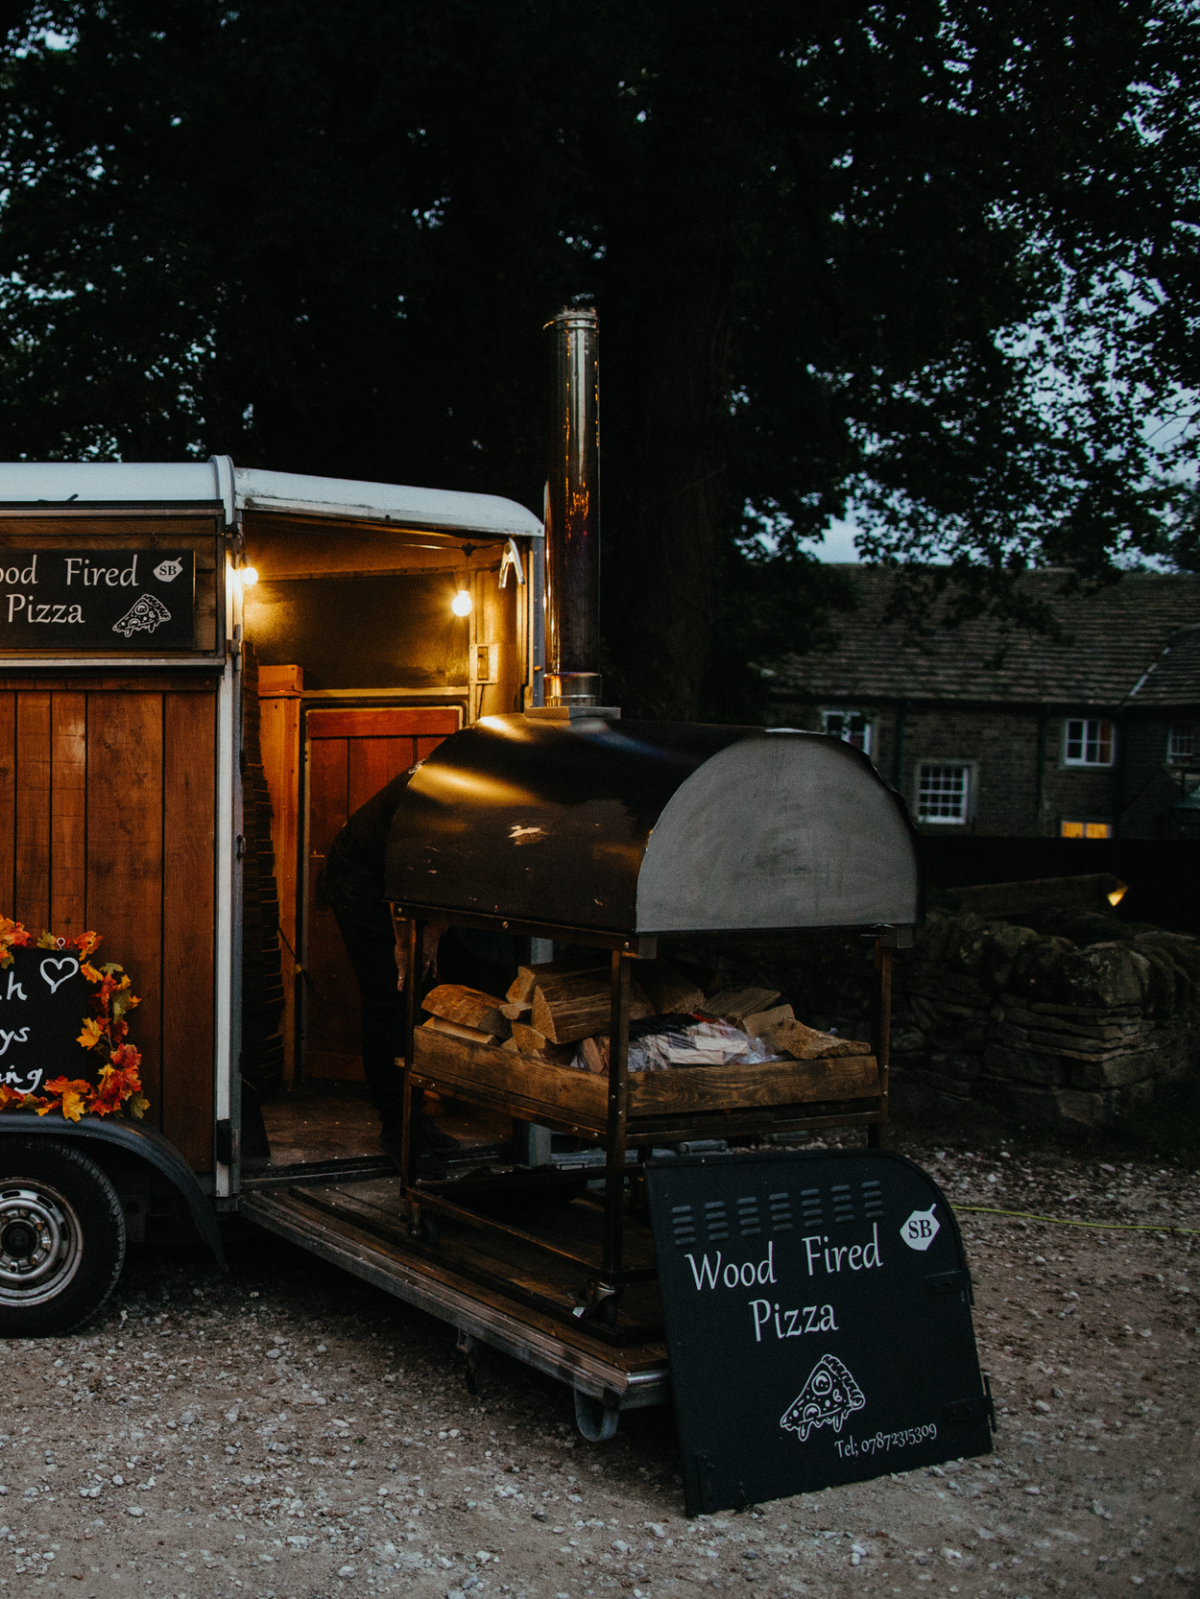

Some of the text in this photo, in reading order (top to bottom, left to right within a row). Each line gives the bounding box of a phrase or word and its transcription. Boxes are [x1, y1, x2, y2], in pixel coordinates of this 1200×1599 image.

[64, 554, 139, 586] Fired
[159, 565, 177, 577] SB
[6, 594, 86, 623] Pizza
[908, 1219, 933, 1240] SB
[685, 1222, 884, 1291] Wood Fired
[749, 1299, 839, 1342] Pizza
[861, 1423, 938, 1454] 07872315309
